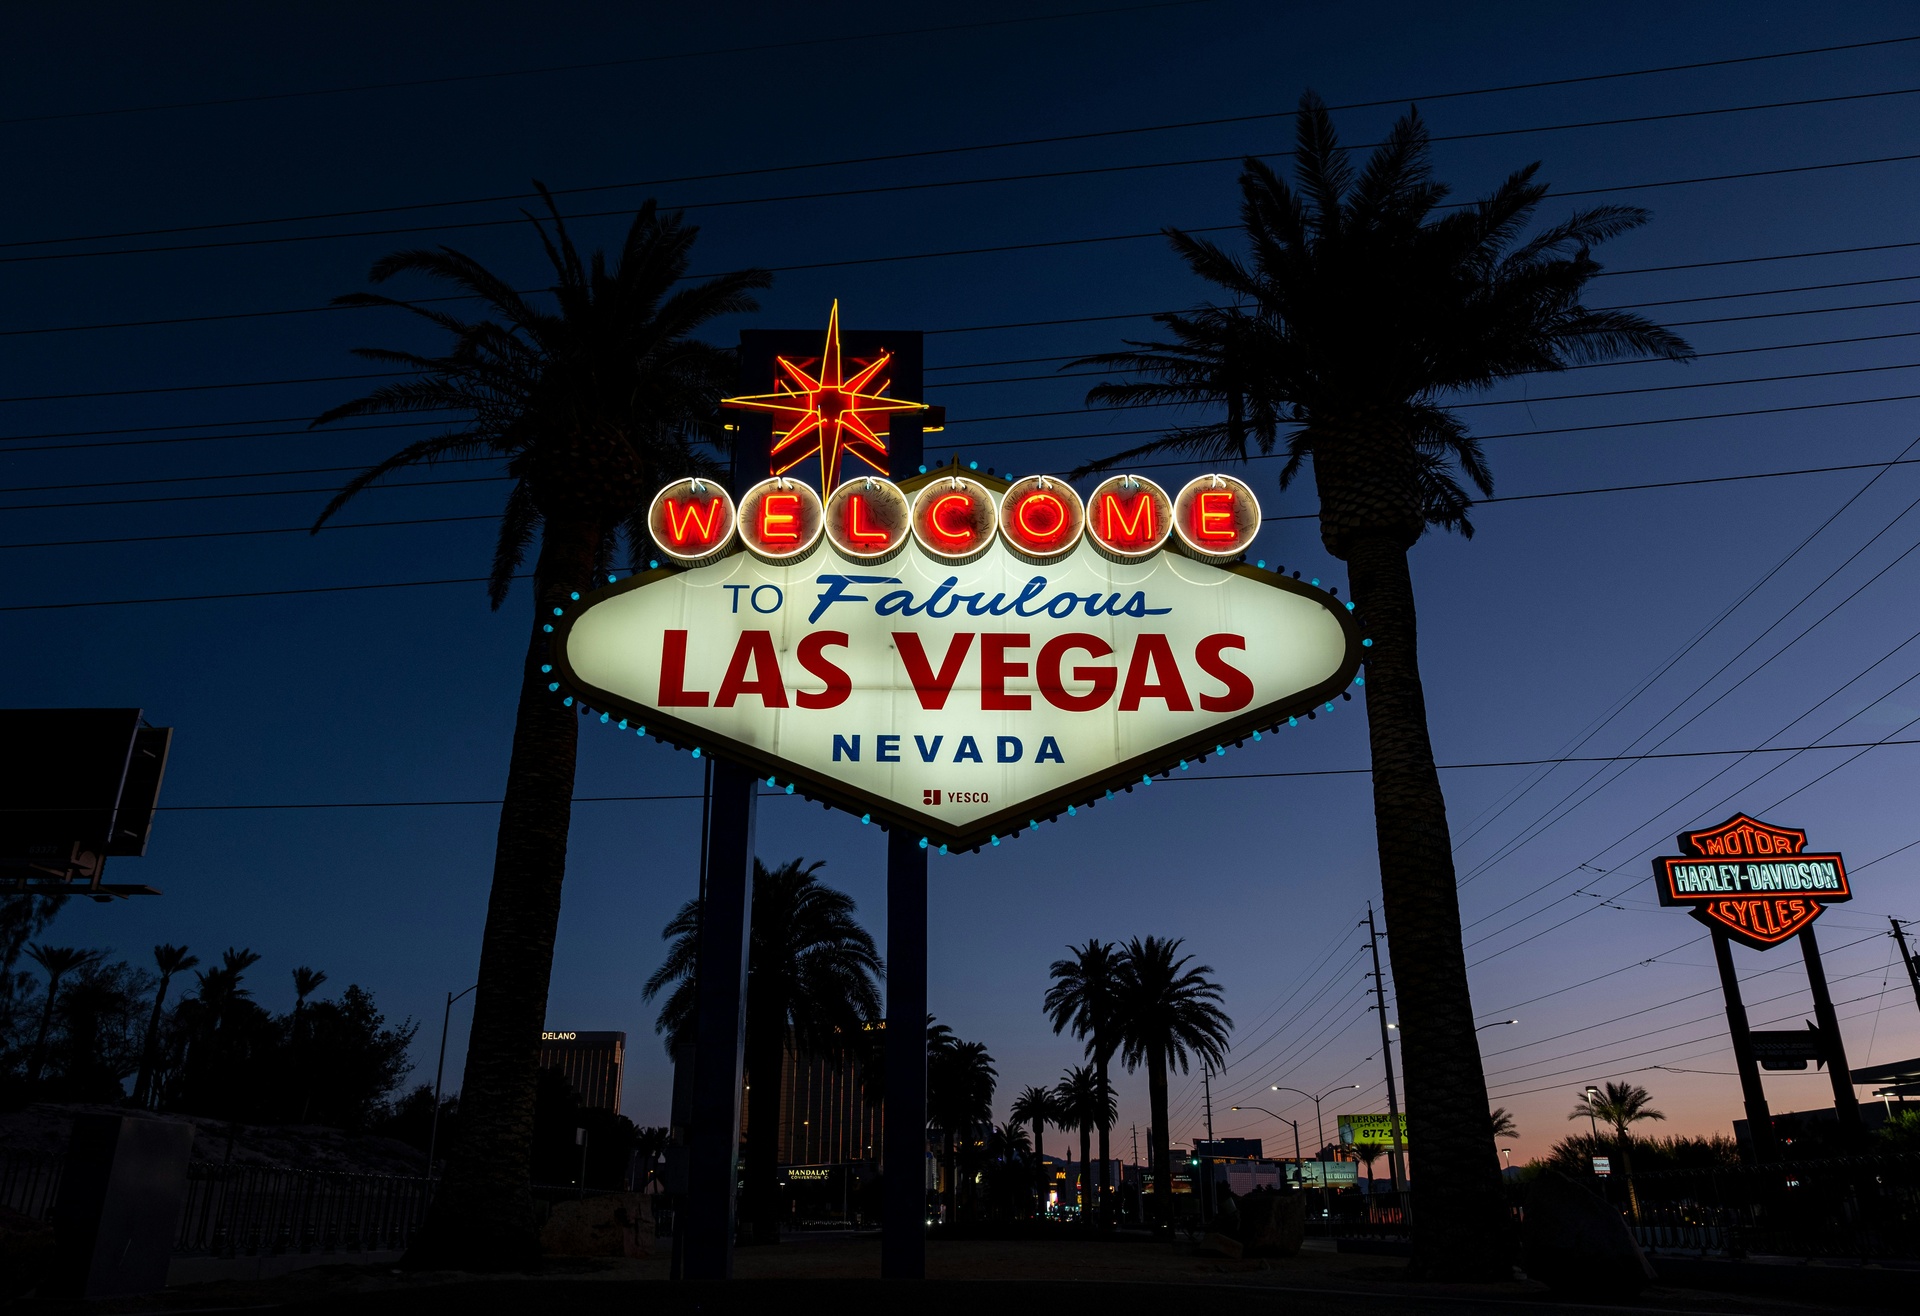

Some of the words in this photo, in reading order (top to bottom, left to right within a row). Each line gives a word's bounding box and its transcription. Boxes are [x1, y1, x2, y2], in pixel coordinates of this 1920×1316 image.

[663, 490, 1239, 546] WELCOME
[722, 583, 784, 614] TO
[807, 574, 1173, 625] Fabulous
[657, 629, 853, 710] LAS
[890, 632, 1255, 713] VEGAS
[831, 734, 1066, 764] NEVADA
[948, 792, 989, 803] YESCO
[1706, 824, 1793, 856] MOTOR
[1674, 861, 1839, 893] HARLEY-DAVIDSON
[1719, 899, 1807, 936] CYCLES
[541, 1032, 577, 1040] DELANO
[1352, 1115, 1388, 1123] LERNER
